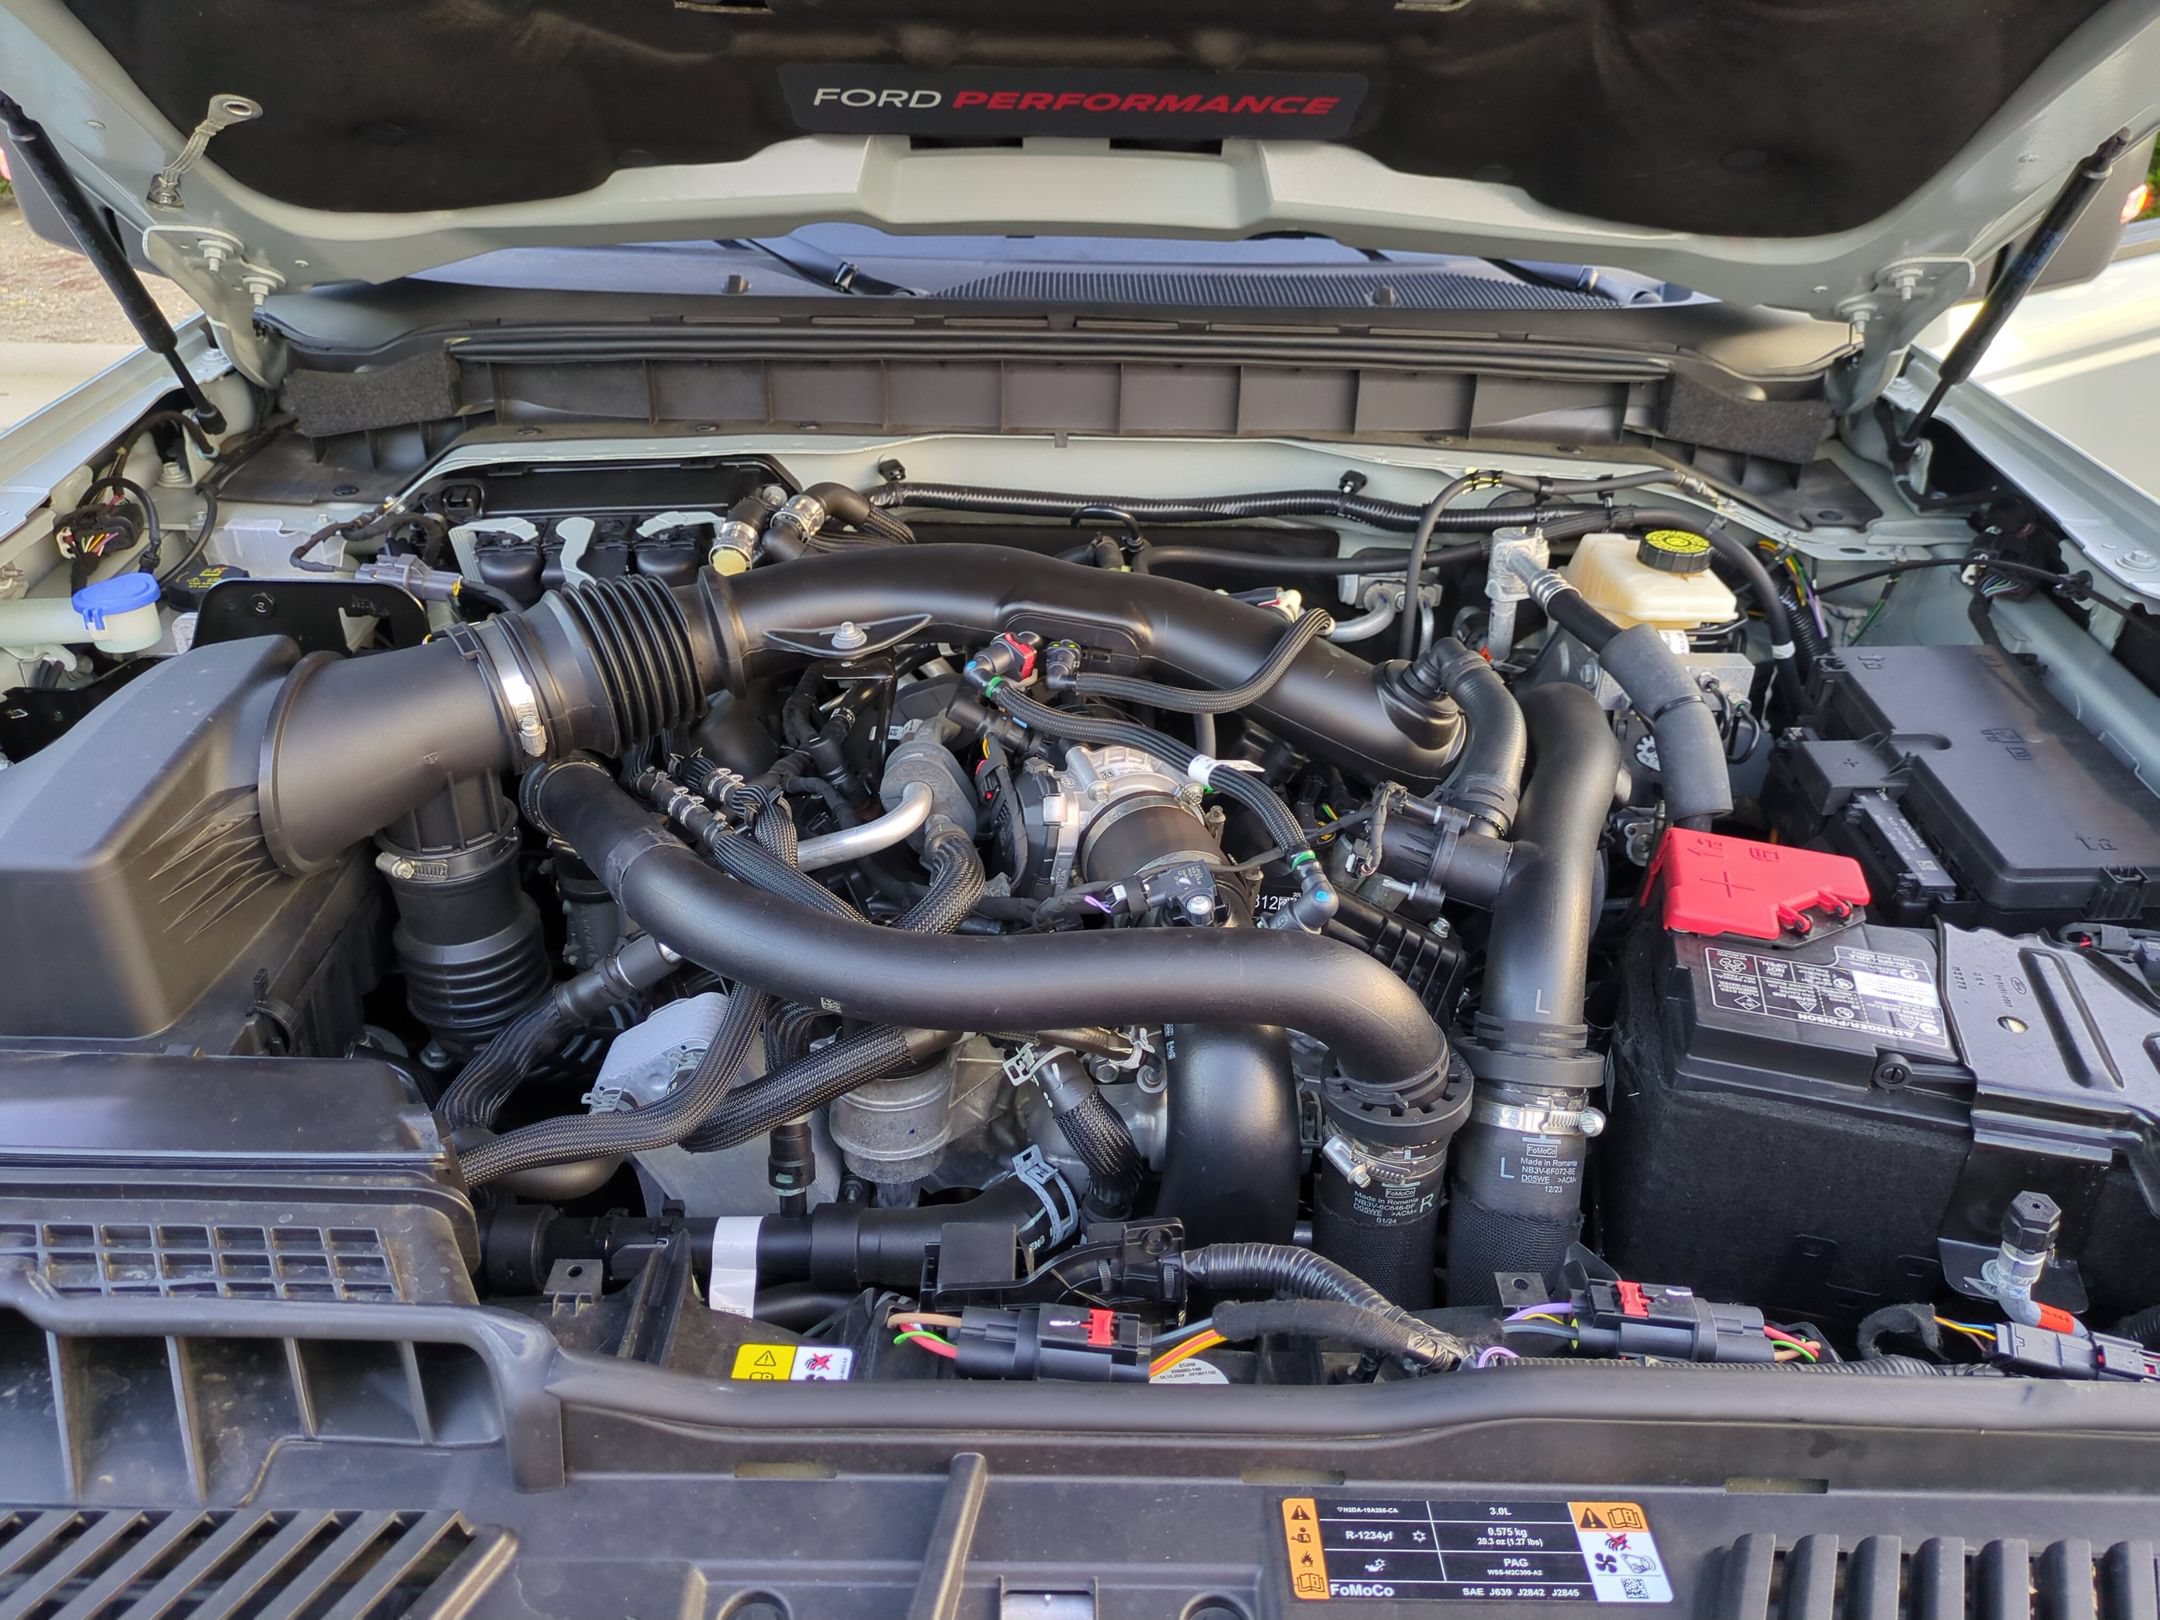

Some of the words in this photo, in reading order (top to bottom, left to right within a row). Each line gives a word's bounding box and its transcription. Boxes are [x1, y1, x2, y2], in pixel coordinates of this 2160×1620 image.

[813, 87, 942, 109] FORD
[952, 90, 1340, 115] PERFORMANCE
[1535, 989, 1551, 1015] L
[1797, 1013, 1903, 1036] DANGER/POISON
[1527, 1146, 1556, 1155] FoMoCo
[1520, 1157, 1542, 1166] Made
[1501, 1157, 1515, 1179] L
[1544, 1185, 1563, 1193] 12/23
[1354, 1190, 1377, 1202] Made
[1386, 1197, 1420, 1206] Romania
[1419, 1193, 1434, 1213] R
[1353, 1203, 1383, 1217] D05WE
[1376, 1217, 1397, 1225] 01/24
[1489, 1507, 1512, 1516] 3.0L
[1345, 1530, 1394, 1543] R-1234yf
[1487, 1527, 1513, 1536] 0.575
[1514, 1528, 1528, 1538] kg
[1477, 1537, 1494, 1546] 20.3
[1507, 1538, 1526, 1547] (1.27
[1527, 1538, 1543, 1548] lbs)
[1503, 1558, 1528, 1567] PAG
[1330, 1583, 1395, 1597] FoMoCo
[1462, 1588, 1485, 1596] SAE
[1489, 1588, 1512, 1597] J639
[1517, 1588, 1546, 1597] J2842
[1551, 1588, 1580, 1597] J2845
